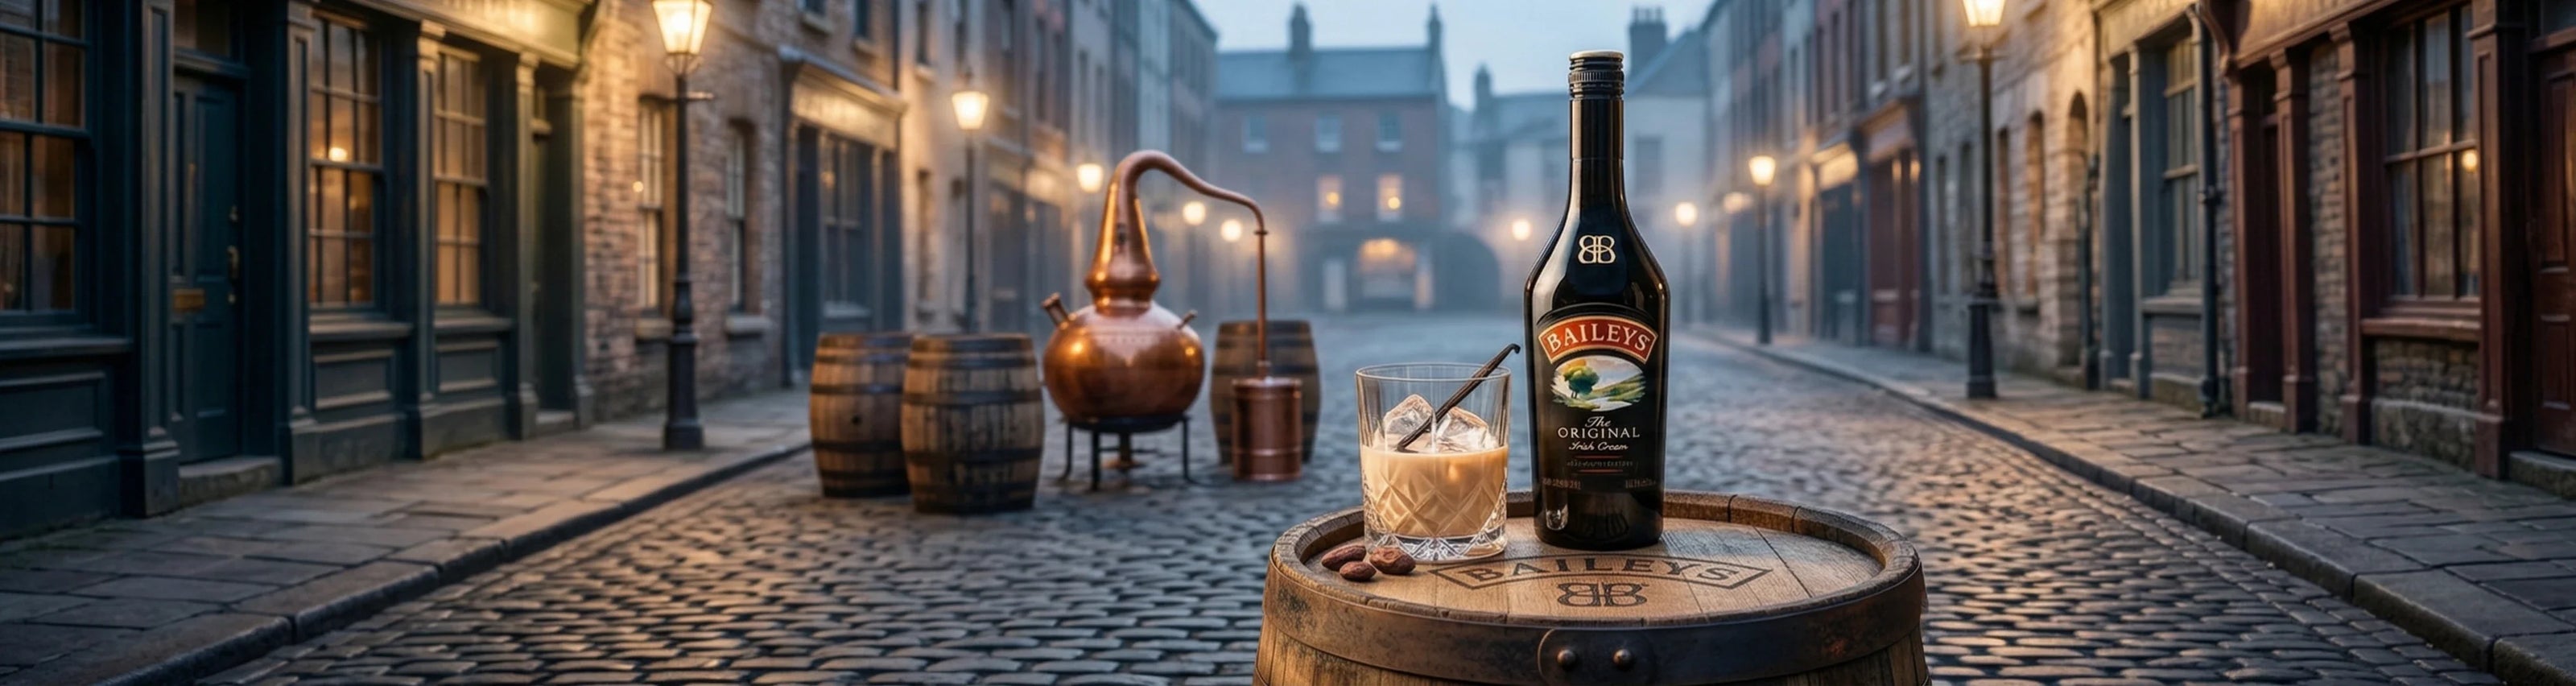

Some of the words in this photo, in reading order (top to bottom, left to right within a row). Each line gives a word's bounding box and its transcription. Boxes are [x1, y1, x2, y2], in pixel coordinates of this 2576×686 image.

[1546, 324, 1650, 353] BAILEYS
[1584, 415, 1611, 428] The
[1558, 427, 1641, 439] ORIGINAL
[1568, 441, 1595, 451] Irish
[1597, 442, 1629, 451] Cream
[1459, 557, 1740, 581] BAILEYS
